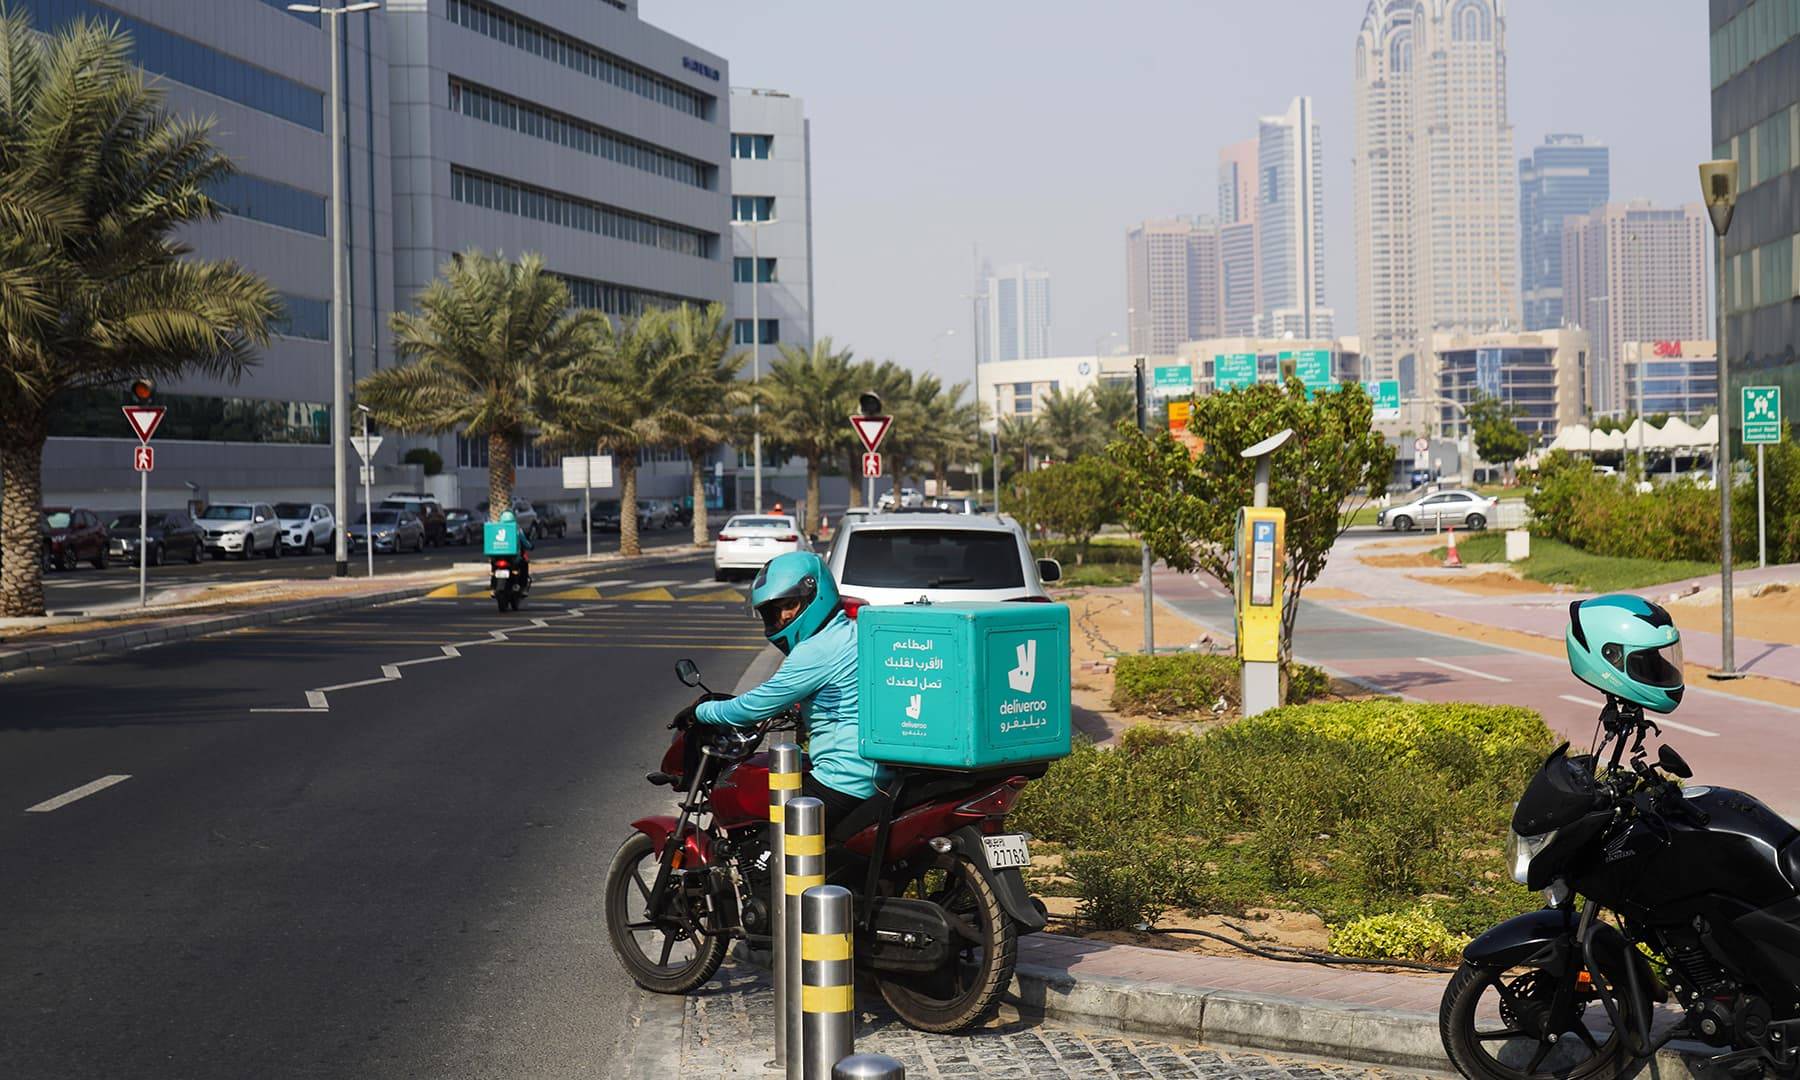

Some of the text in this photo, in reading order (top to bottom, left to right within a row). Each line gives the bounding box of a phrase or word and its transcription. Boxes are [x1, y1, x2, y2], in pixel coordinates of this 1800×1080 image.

[1653, 341, 1681, 355] 3M
[1258, 525, 1270, 540] P
[893, 639, 932, 651] المطاعم
[885, 657, 914, 669] لقلبك
[886, 676, 942, 690] تصل لعندك
[1000, 699, 1047, 715] deliveroo
[1000, 716, 1047, 733] ديليفرو
[994, 849, 1026, 866] 27763
